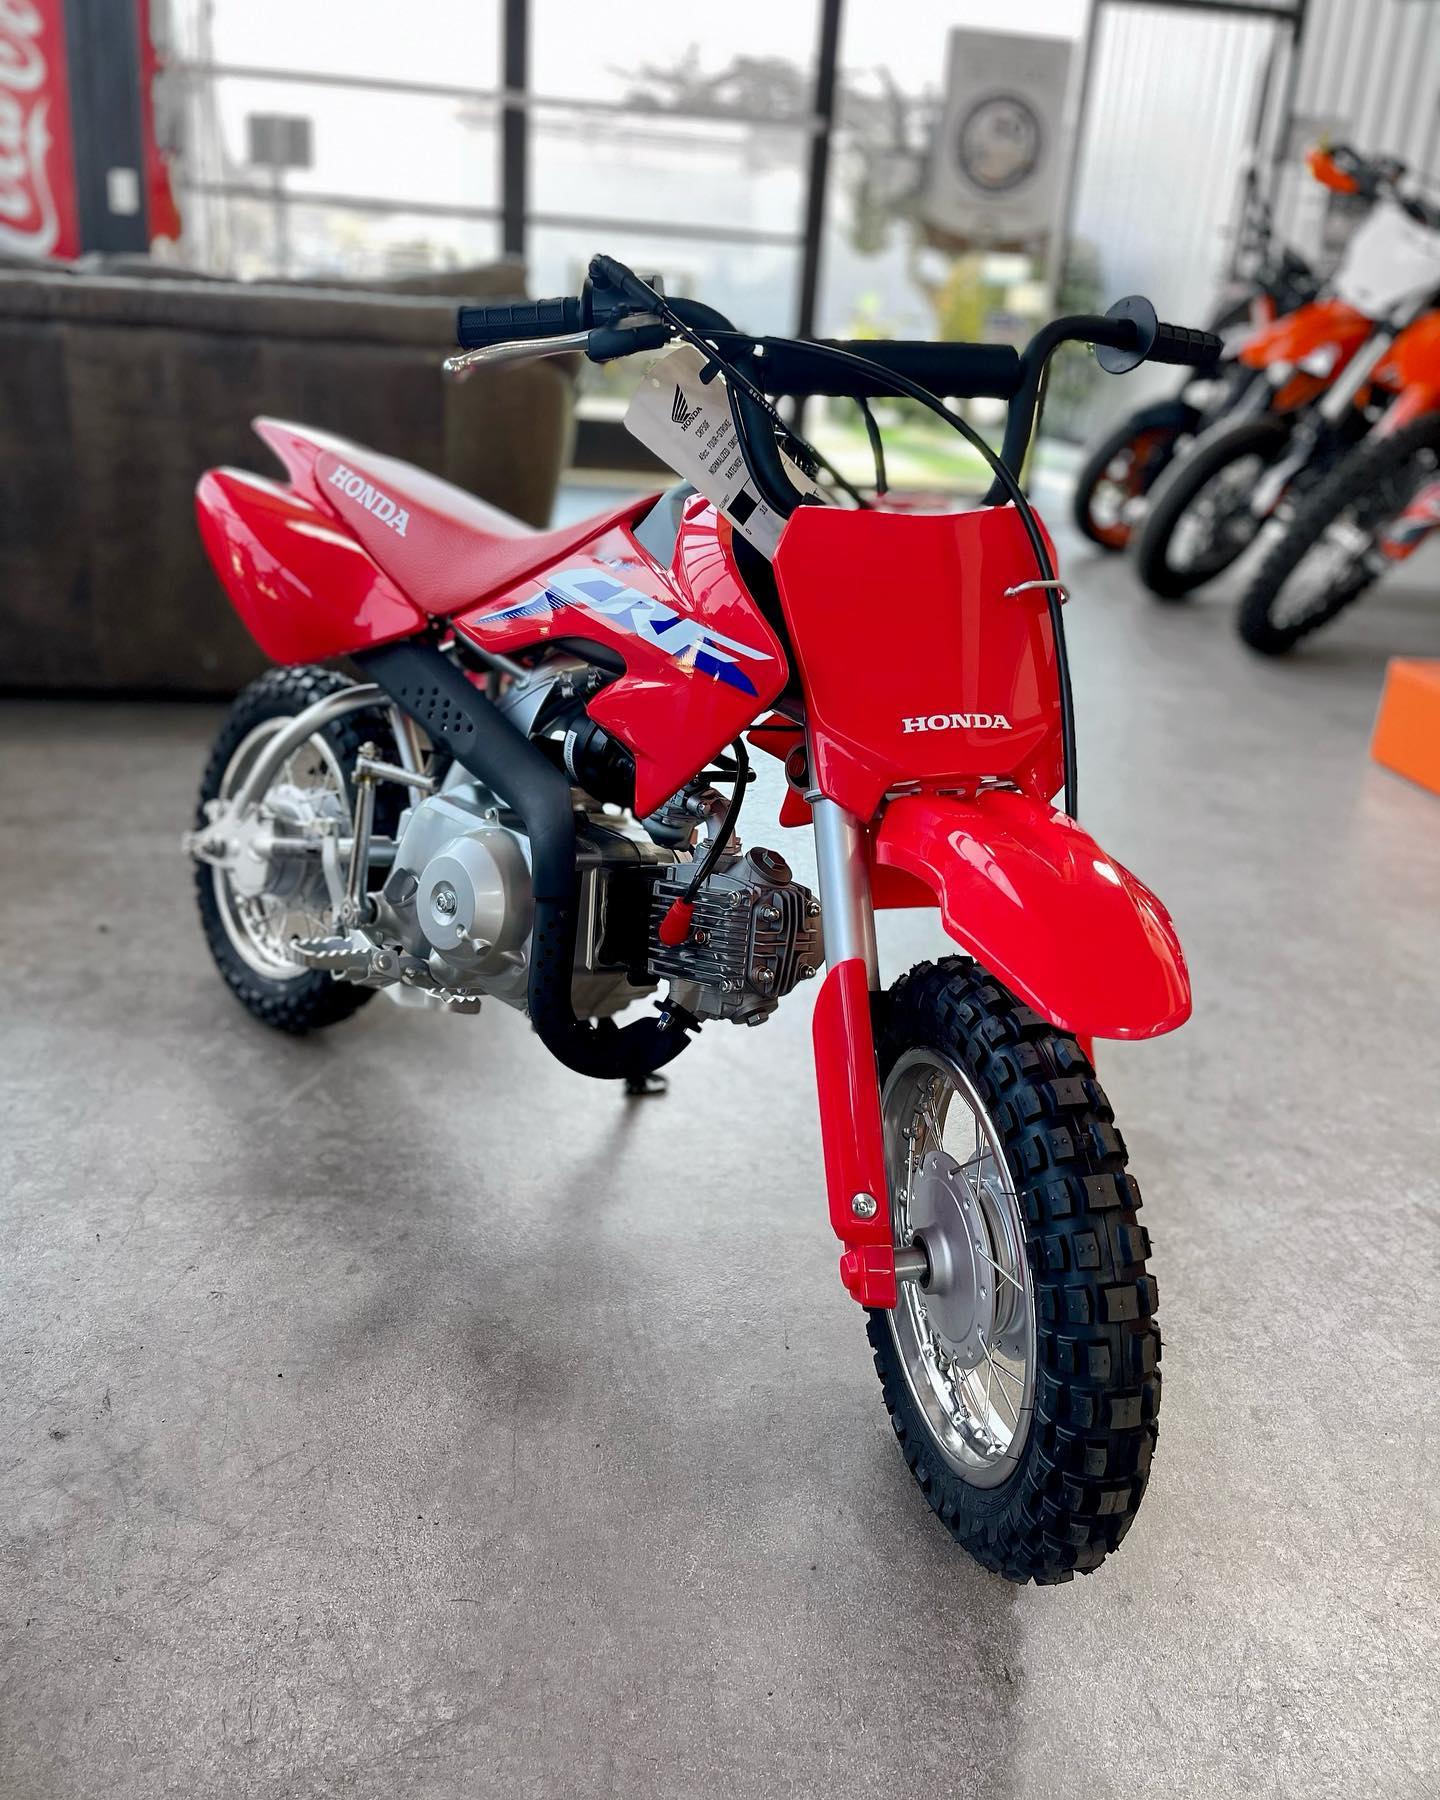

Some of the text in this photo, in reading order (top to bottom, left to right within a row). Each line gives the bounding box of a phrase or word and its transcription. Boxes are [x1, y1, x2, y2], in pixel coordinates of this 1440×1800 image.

[681, 406, 703, 432] HONDA
[695, 419, 710, 438] CRF50F
[706, 418, 732, 450] FOUR-STROKE
[708, 433, 740, 475] NORMALIZED EMIS
[328, 463, 410, 538] HONDA
[547, 567, 776, 664] CRF
[901, 713, 1013, 733] HONDA
